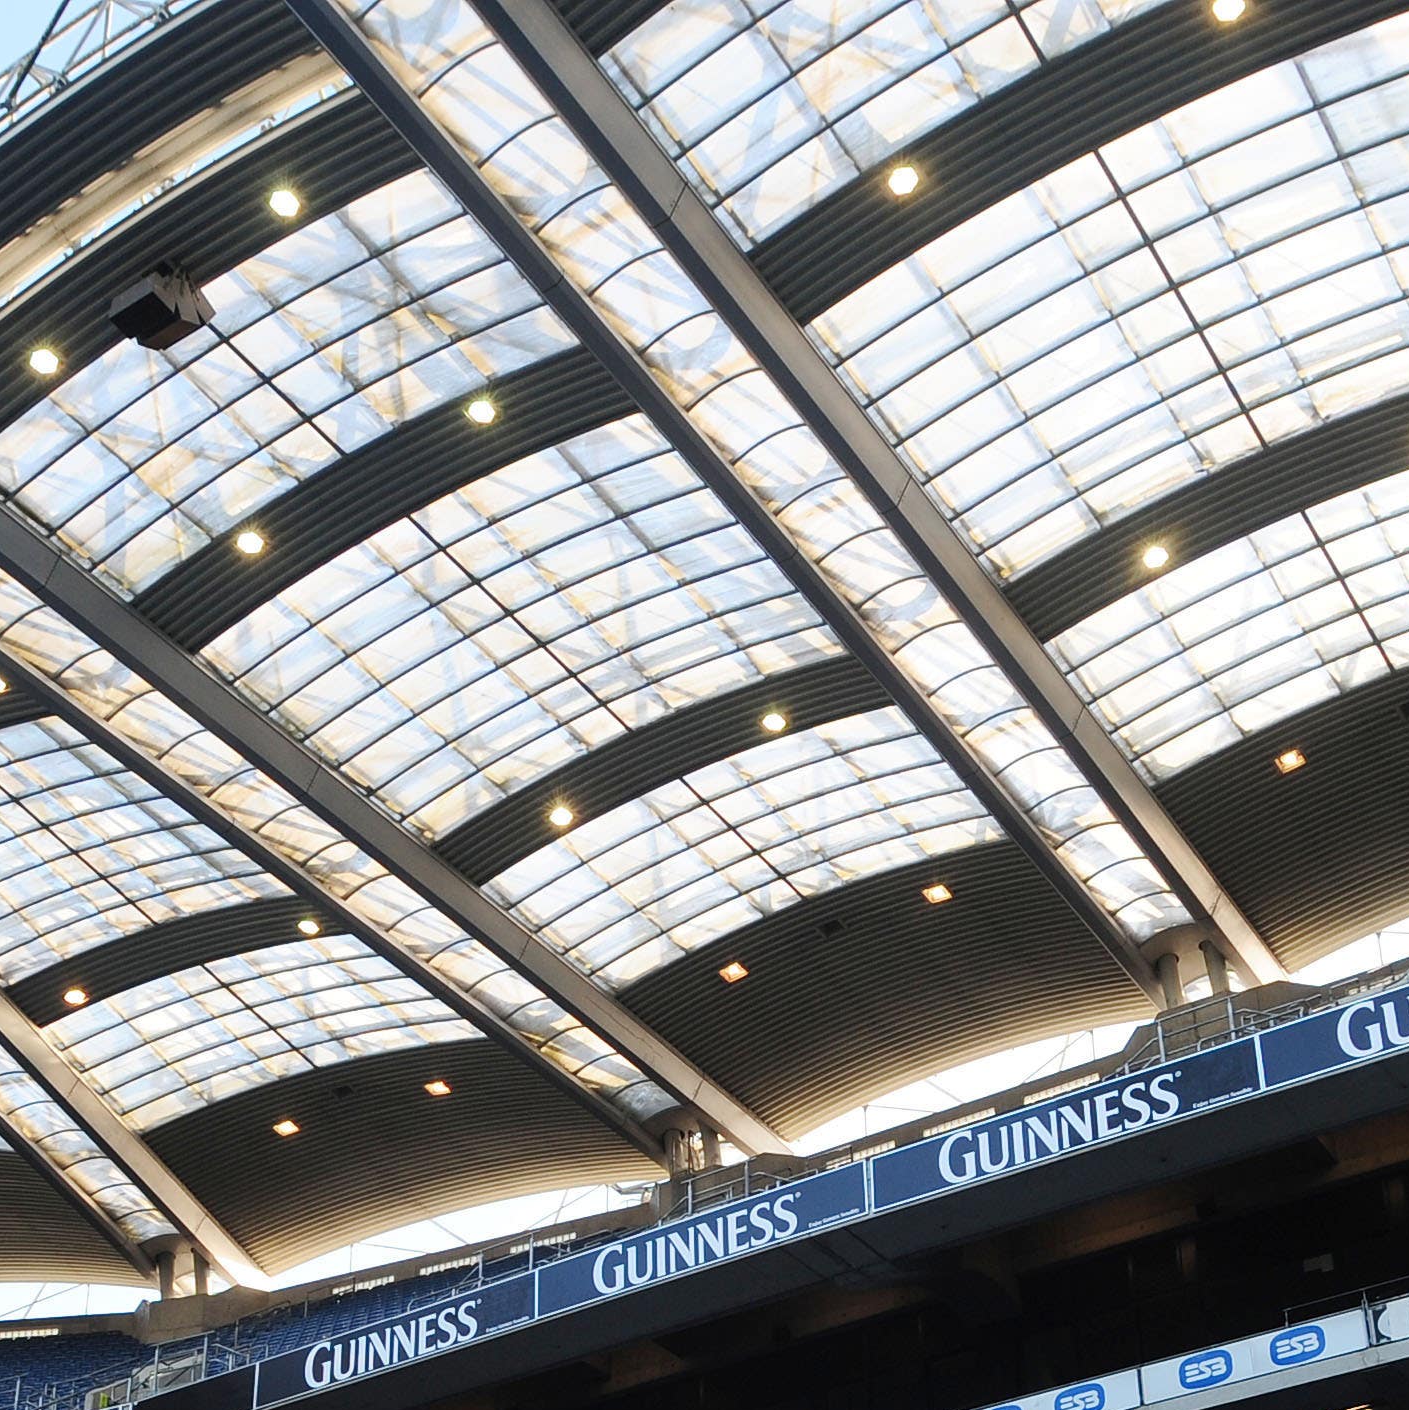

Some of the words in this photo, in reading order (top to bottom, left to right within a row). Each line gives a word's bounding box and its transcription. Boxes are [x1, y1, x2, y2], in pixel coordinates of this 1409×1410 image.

[938, 1072, 1180, 1184] GUINNESS
[592, 1193, 798, 1295] GUINNESS
[304, 1300, 478, 1389] GUINNESS
[1184, 1357, 1228, 1383] ESB
[1275, 1332, 1320, 1360] ESB
